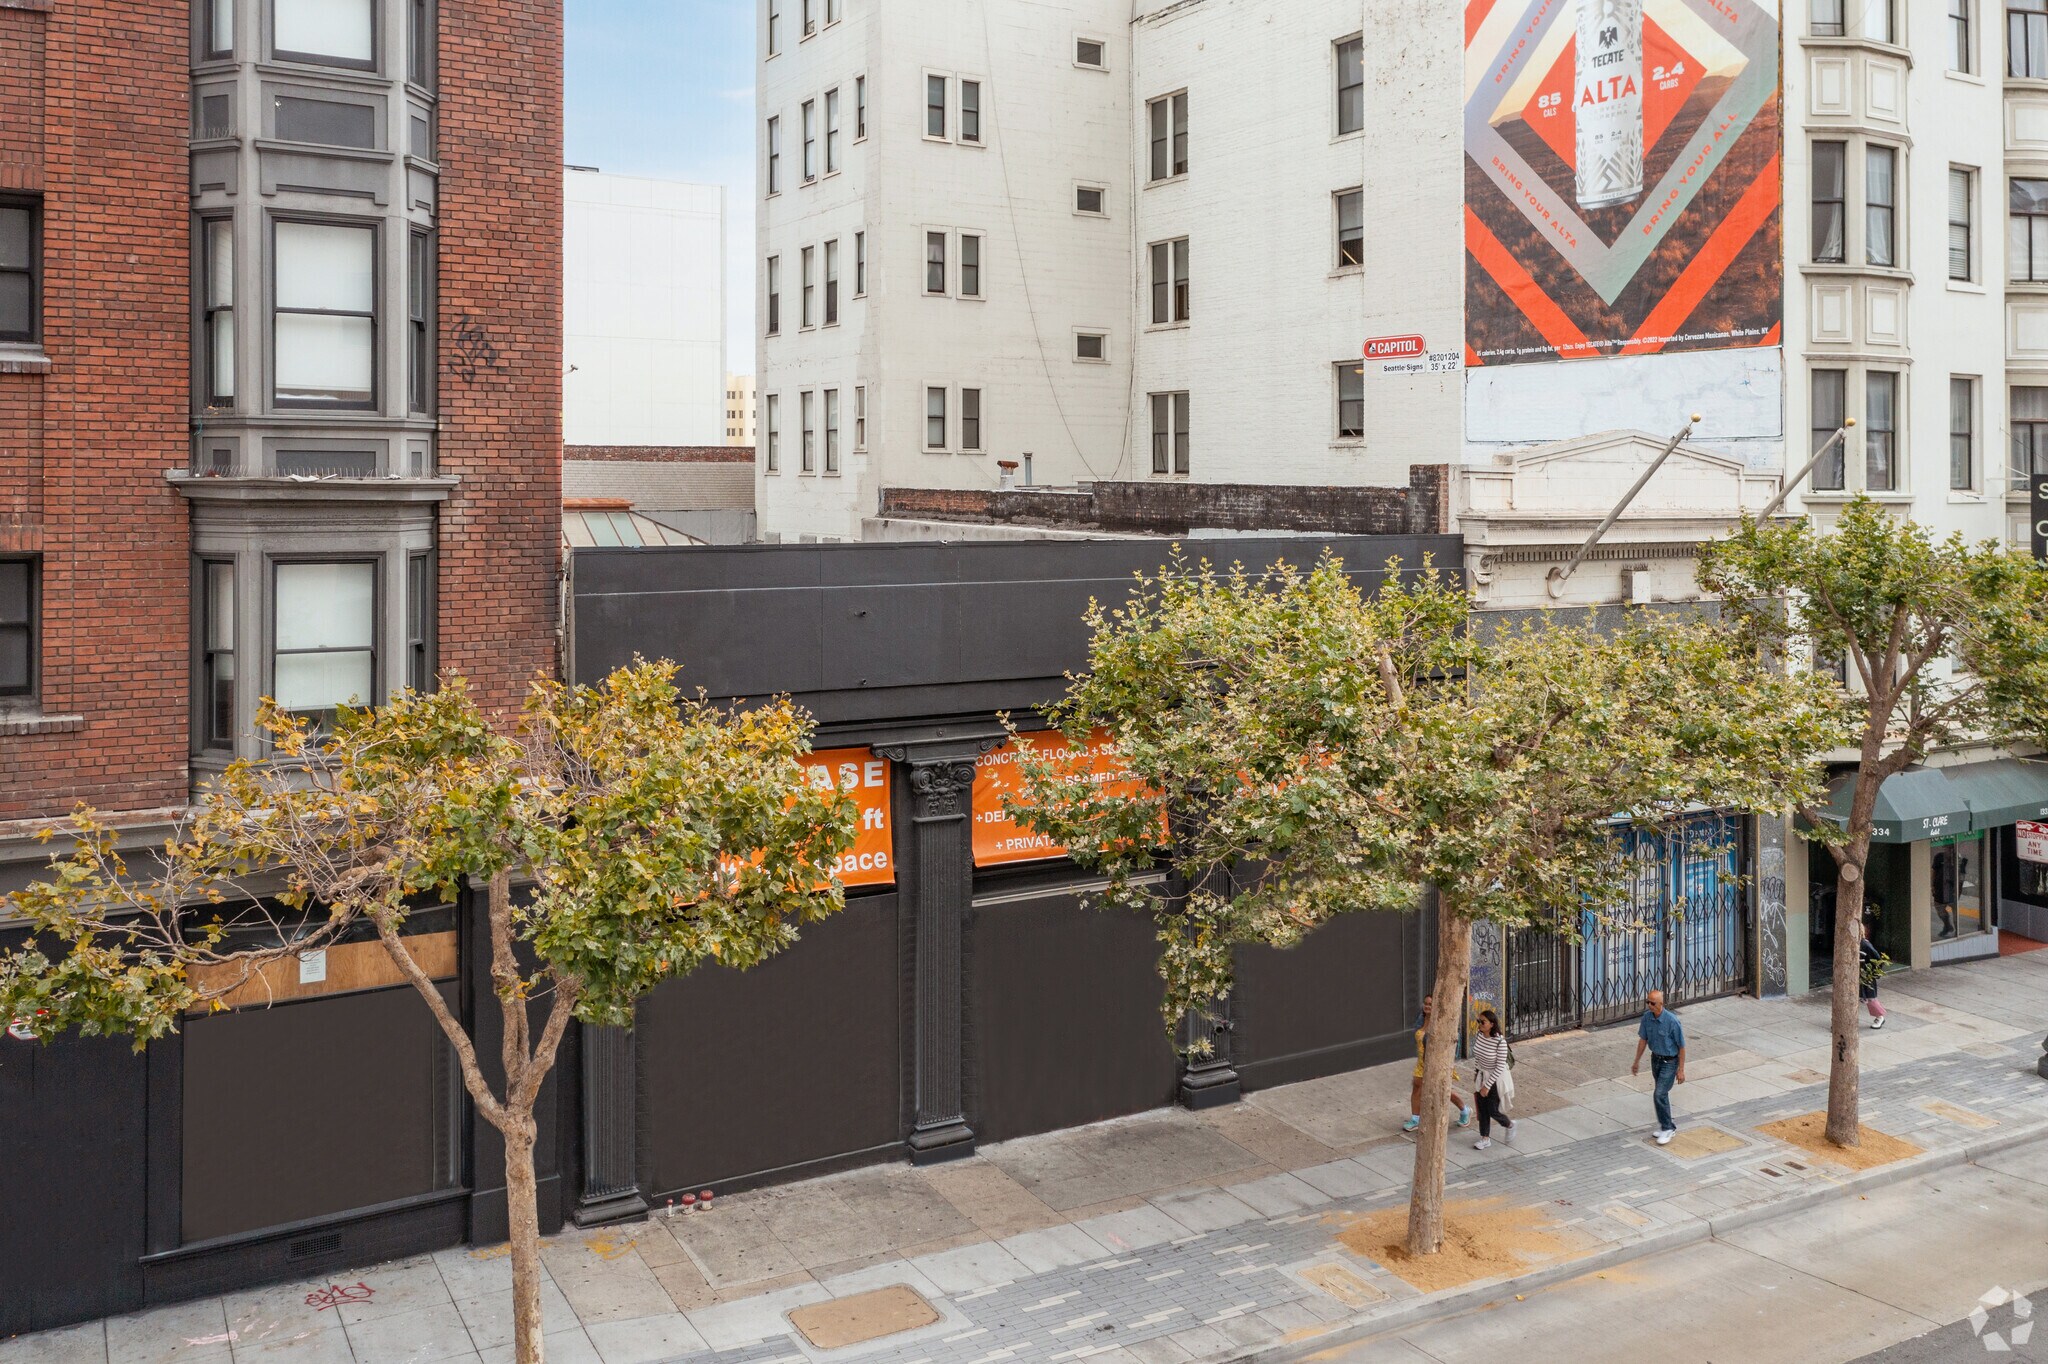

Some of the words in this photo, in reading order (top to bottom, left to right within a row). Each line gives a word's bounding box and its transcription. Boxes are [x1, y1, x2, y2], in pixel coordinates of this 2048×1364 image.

[1494, 38, 1526, 84] BRING
[1592, 49, 1624, 68] TECATE
[1652, 61, 1685, 81] 2.4
[1580, 74, 1637, 107] ALTA
[1659, 78, 1679, 90] CARBS
[1538, 91, 1561, 108] 85
[1543, 107, 1557, 118] CALS
[1642, 188, 1679, 235] BRING
[1679, 144, 1712, 185] YOUR
[1713, 113, 1739, 142] ALL
[1491, 155, 1523, 190] BRING
[1523, 188, 1550, 220] YOUR
[1550, 220, 1577, 249] ALTA
[1377, 340, 1418, 354] CAPITOL
[1383, 363, 1405, 372] Seattle
[1406, 363, 1423, 372] Signs
[863, 807, 884, 830] ft
[2027, 831, 2048, 841] STOPPIN
[2027, 847, 2043, 857] TIME
